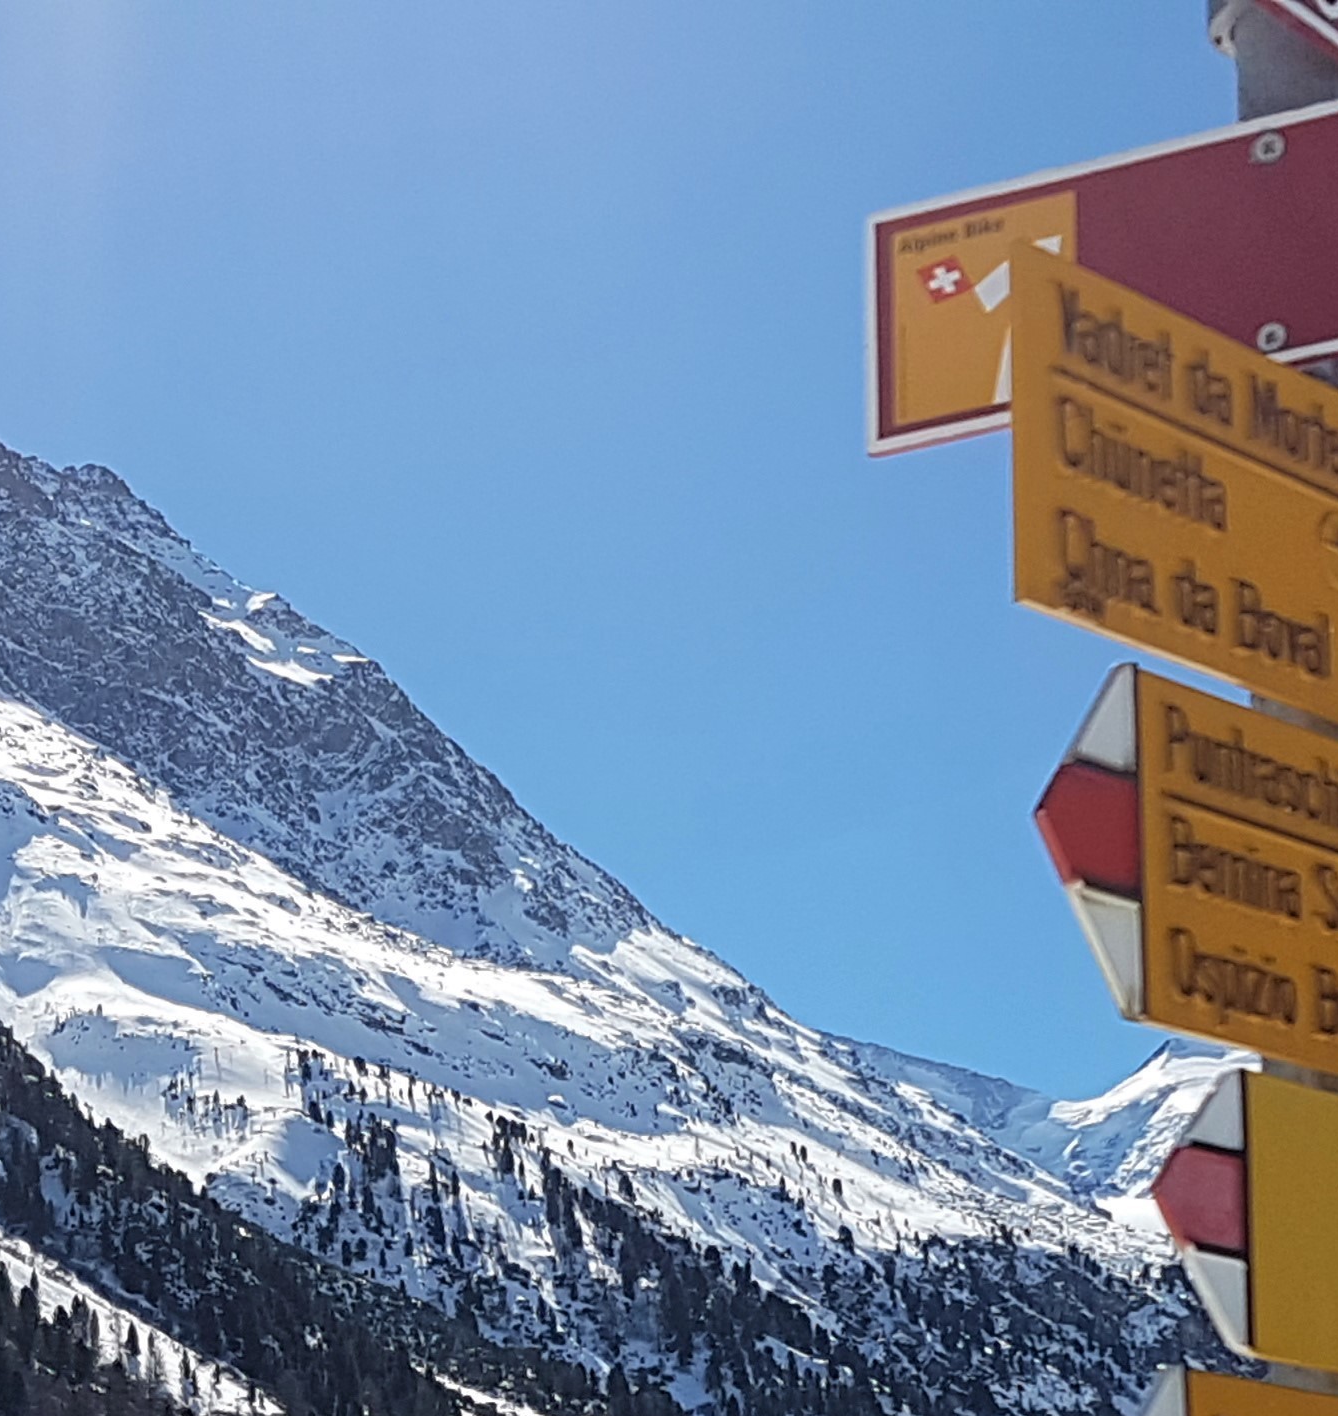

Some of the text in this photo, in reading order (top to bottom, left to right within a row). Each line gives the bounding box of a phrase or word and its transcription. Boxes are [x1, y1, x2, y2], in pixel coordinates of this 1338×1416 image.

[1188, 350, 1234, 428] da
[1171, 558, 1216, 637] da
[1168, 814, 1303, 920] Bernina
